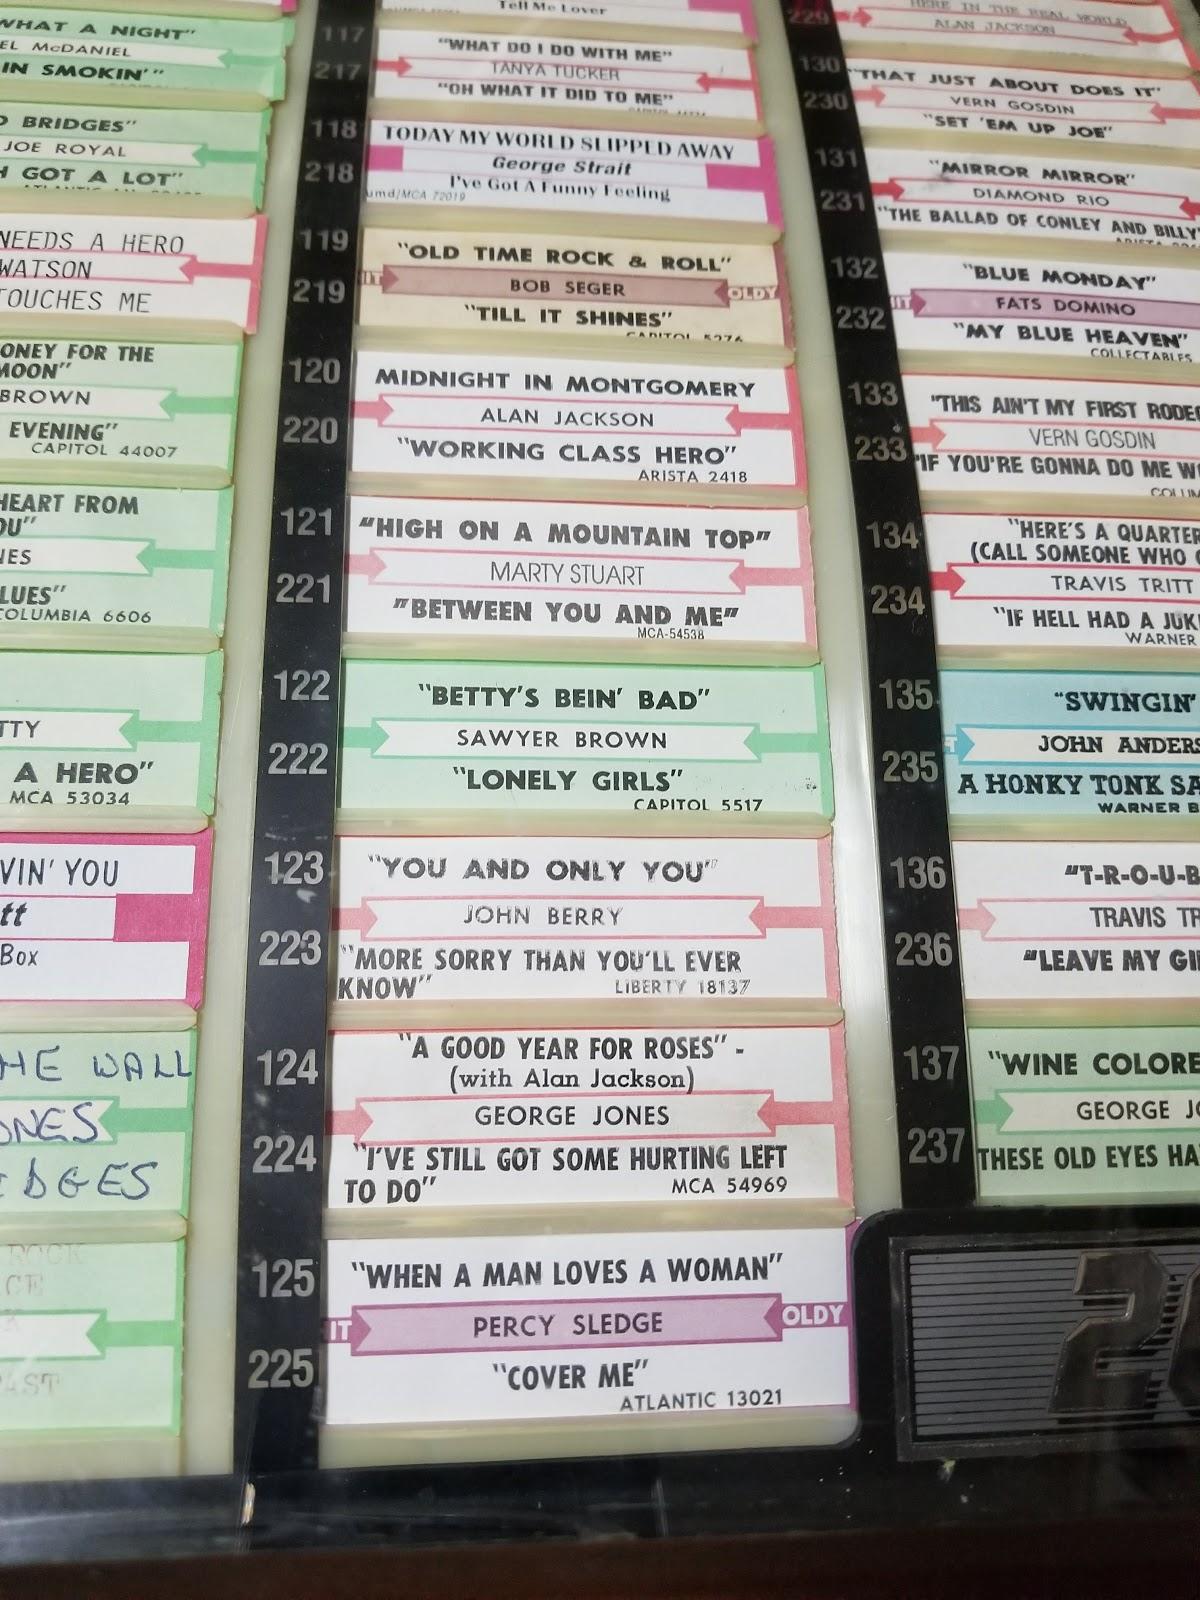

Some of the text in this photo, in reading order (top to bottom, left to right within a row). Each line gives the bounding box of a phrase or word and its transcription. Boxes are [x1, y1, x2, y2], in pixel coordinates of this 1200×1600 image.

[111, 24, 196, 40] NIGHT"
[322, 26, 364, 43] 117
[32, 42, 131, 58] McDANIEL
[314, 62, 359, 80] 217
[490, 61, 620, 81] TANYA TUCKER
[801, 57, 840, 72] 130
[804, 93, 848, 110] 230
[951, 96, 1074, 115] VERN GOSDIN
[22, 116, 137, 133] BRIDGES"
[312, 121, 356, 139] 118
[55, 142, 126, 158] ROYAL
[815, 149, 858, 167] 131
[305, 163, 353, 183] 218
[492, 156, 632, 176] George Strait
[930, 160, 1135, 186] "MIRROR MIRROR"
[122, 171, 184, 187] LOT"
[820, 191, 865, 211] 231
[973, 188, 1109, 207] DIAMOND RIO
[121, 233, 185, 255] HERO
[301, 230, 348, 249] 119
[397, 242, 732, 272] "OLD TIME ROCK & ROLL"
[831, 258, 878, 278] 132
[963, 264, 1155, 290] "BLUE MONDAY"
[294, 280, 345, 303] 219
[510, 280, 626, 297] BOB SEGER
[727, 286, 777, 301] OLDY
[836, 306, 885, 329] 232
[996, 297, 1135, 316] FATS DOMINO
[954, 323, 1187, 348] "MY BLUE HEAVEN"
[289, 358, 340, 383] 120
[375, 369, 755, 398] MIDNIGHT IN MONTGOMERY
[849, 383, 898, 405] 133
[480, 408, 654, 428] ALAN JACKSON
[9, 422, 118, 441] EVENING"
[283, 417, 338, 443] 220
[1029, 427, 1156, 449] VERN GOSDIN
[32, 442, 178, 458] CAPITOL 44007
[397, 436, 736, 465] "WORKING CLASS HERO"
[855, 437, 906, 460] 233
[638, 468, 747, 483] ARISTA 2418
[950, 456, 1100, 476] YOU'RE GONNA
[75, 494, 139, 515] FROM
[281, 508, 332, 536] 121
[866, 522, 918, 548] 134
[971, 542, 1186, 565] (CALL SOMEONE WHO
[490, 562, 645, 586] MARTY STUART
[1051, 576, 1193, 593] TRAVIS TRITT
[276, 574, 330, 603] 221
[871, 585, 925, 614] 234
[103, 611, 152, 624] 6606
[393, 598, 739, 628] "BETWEEN YOU AND ME"
[1034, 610, 1079, 628] HELL
[1125, 632, 1196, 646] WARNER
[274, 670, 330, 700] 122
[879, 679, 932, 710] 135
[418, 683, 710, 710] "BETTY'S BEIN' BAD"
[457, 729, 668, 750] SAWYER BROWN
[1039, 735, 1102, 752] JOHN
[269, 743, 328, 775] 222
[882, 751, 938, 782] 235
[55, 761, 154, 785] HERO"
[453, 766, 683, 792] "LONELY GIRLS"
[985, 774, 1161, 795] HONKY TONK
[10, 791, 130, 806] MCA 53034
[1098, 803, 1180, 813] WARNER
[65, 859, 119, 887] YOU
[265, 851, 323, 884] 123
[890, 857, 946, 889] 136
[464, 905, 623, 926] JOHN BERRY
[1090, 907, 1166, 928] TRAVIS
[259, 930, 321, 965] 223
[895, 933, 952, 966] 236
[1024, 949, 1112, 972] "LEAVE
[615, 978, 751, 996] LIBERTY 18137
[399, 1032, 726, 1060] "A GOOD YEAR FOR ROSES"
[93, 1050, 192, 1079] WALL
[257, 1048, 318, 1085] 124
[903, 1046, 959, 1080] 137
[988, 1050, 1077, 1075] "WINE
[449, 1066, 695, 1095] (with Alan Jackson)
[474, 1105, 671, 1127] GEORGE JONES
[1077, 1101, 1169, 1120] GEORGE
[253, 1136, 316, 1173] 224
[907, 1128, 965, 1163] 237
[1054, 1144, 1158, 1169] OLD EYES
[672, 1176, 788, 1195] MCA 54969
[252, 1259, 314, 1297] 125
[352, 1252, 783, 1289] "WHEN A MAN LOVES A WOMAN"
[473, 1312, 663, 1338] PERCY SLEDGE
[782, 1304, 844, 1327] OLDY
[249, 1349, 313, 1389] 225
[493, 1360, 648, 1390] "COVER ME"
[620, 1390, 783, 1412] ATLANTIC 13021
